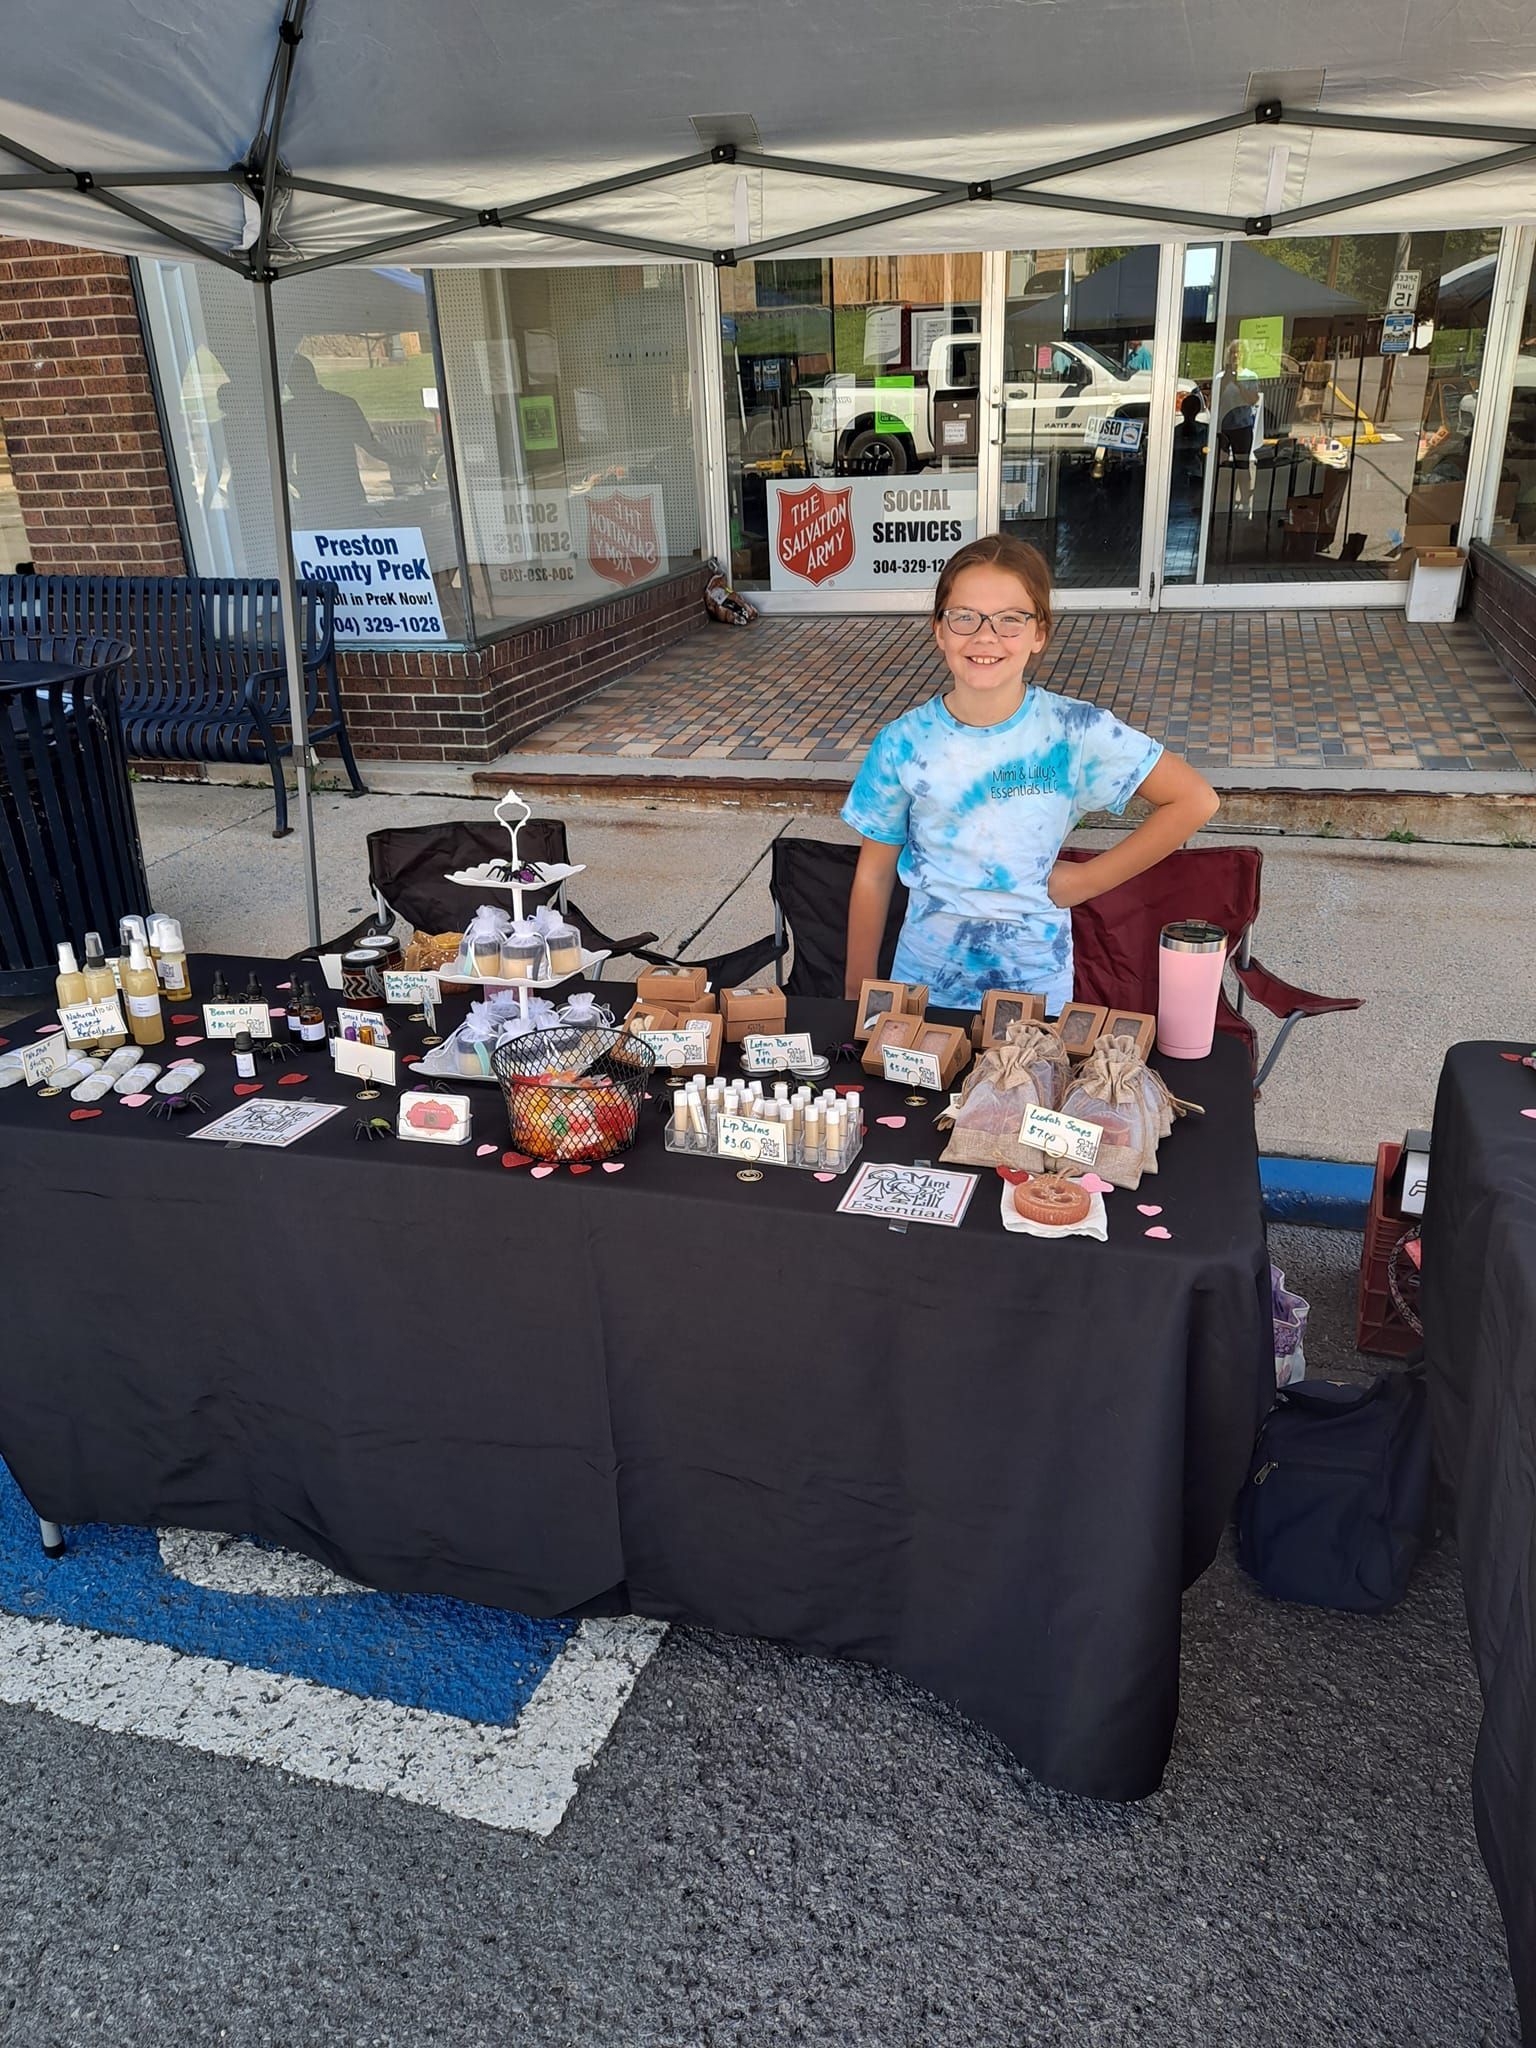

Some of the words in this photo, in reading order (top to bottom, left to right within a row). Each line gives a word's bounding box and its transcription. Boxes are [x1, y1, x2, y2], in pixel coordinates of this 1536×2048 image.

[883, 489, 951, 512] SOCIAL
[791, 493, 820, 527] THE
[782, 498, 847, 562] SALVATION
[872, 520, 962, 543] SERVICES
[315, 534, 399, 556] Preston
[807, 527, 846, 575] ARMY
[300, 560, 372, 585] County
[377, 558, 431, 581] PreK
[873, 559, 948, 574] 304-329-12
[315, 591, 349, 606] oll
[350, 592, 363, 605] in
[365, 591, 397, 605] PreK
[399, 591, 433, 605] Now!
[319, 616, 360, 636] (04)
[363, 616, 441, 633] 329-1028
[993, 766, 1016, 782] Mimi
[1019, 767, 1025, 780] &
[991, 781, 1040, 798] Essentials
[66, 1008, 96, 1021] Natural
[208, 1007, 236, 1017] Beard
[239, 1007, 252, 1016] Oil
[672, 1033, 691, 1043] Bar
[775, 1038, 793, 1048] Bar
[755, 1049, 771, 1057] Tin
[204, 1127, 290, 1143] Essentials
[722, 1118, 739, 1133] Lip
[740, 1119, 769, 1135] Balms
[724, 1135, 751, 1150] $3.00
[902, 1171, 951, 1190] Mimi
[850, 1200, 954, 1221] Essentials
